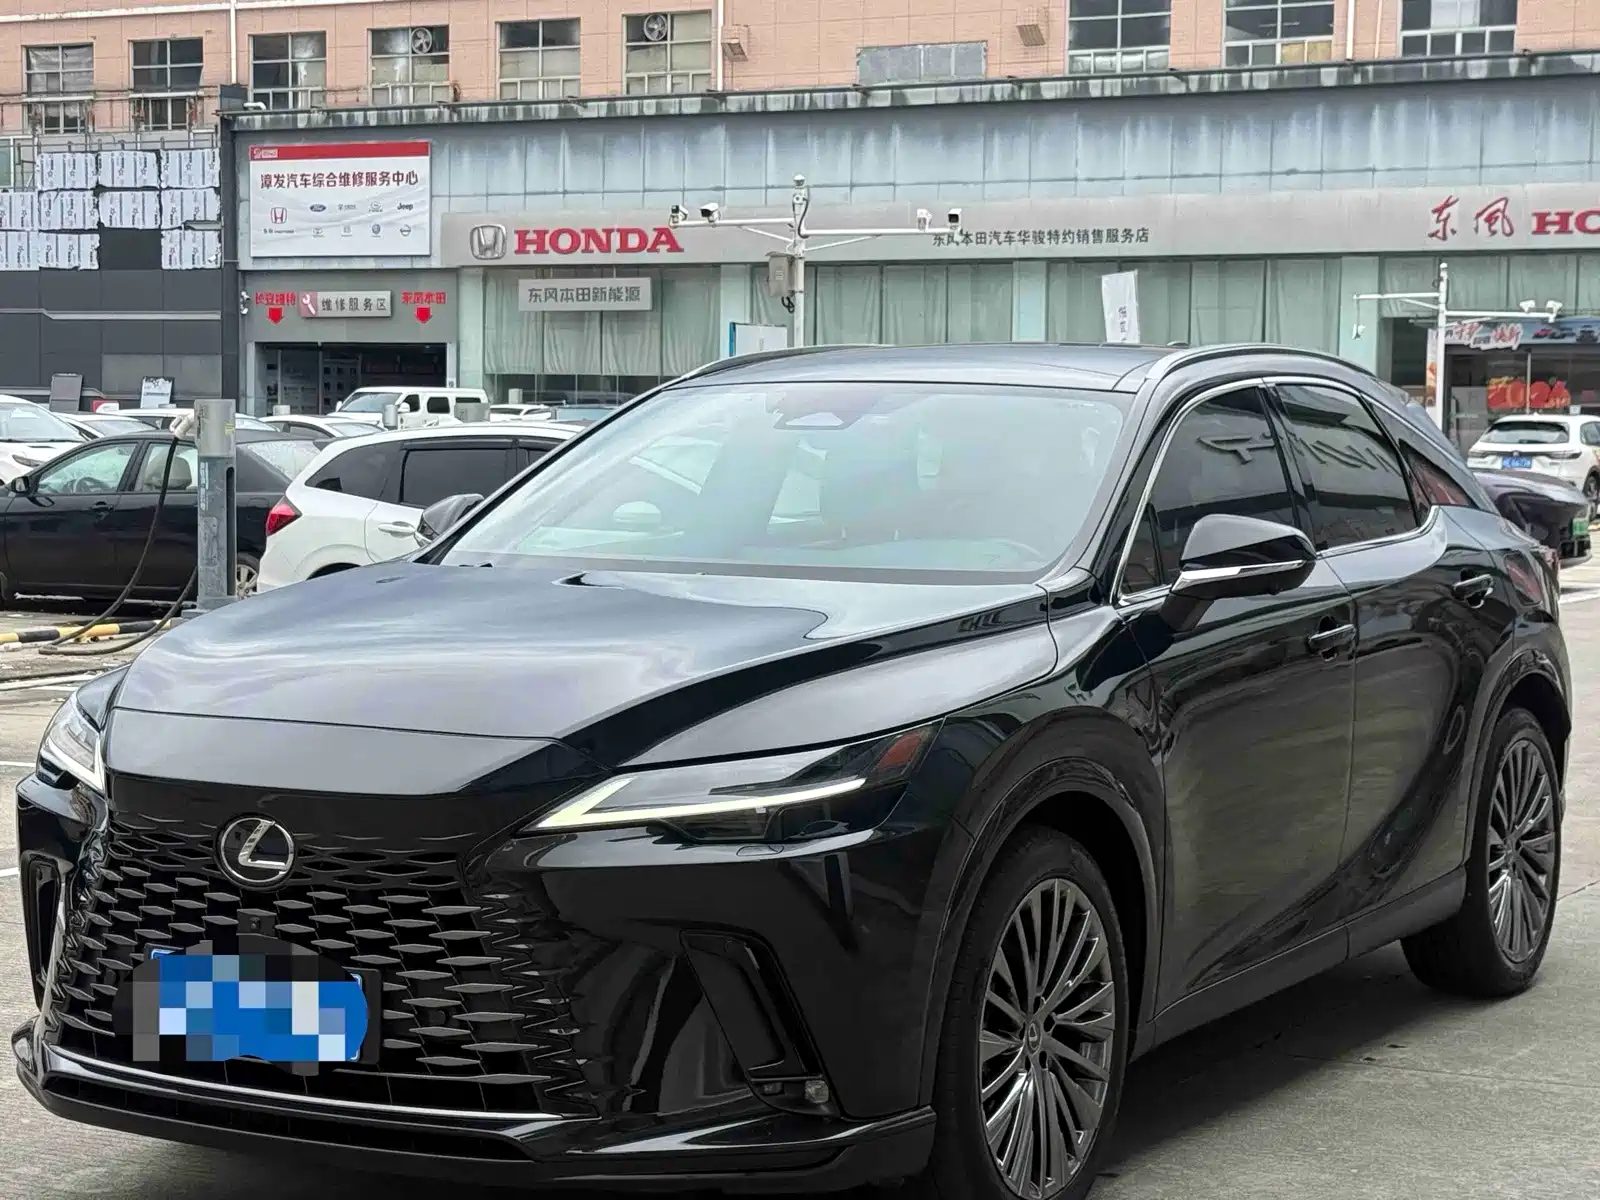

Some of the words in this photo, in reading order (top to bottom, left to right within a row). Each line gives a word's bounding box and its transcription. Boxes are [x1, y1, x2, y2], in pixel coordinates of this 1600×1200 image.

[260, 170, 419, 190] 漳发汽车综合维修服务中心
[513, 227, 684, 255] HONDA
[321, 297, 387, 312] 维修服务区
[527, 286, 641, 304] 东风本田新能源
